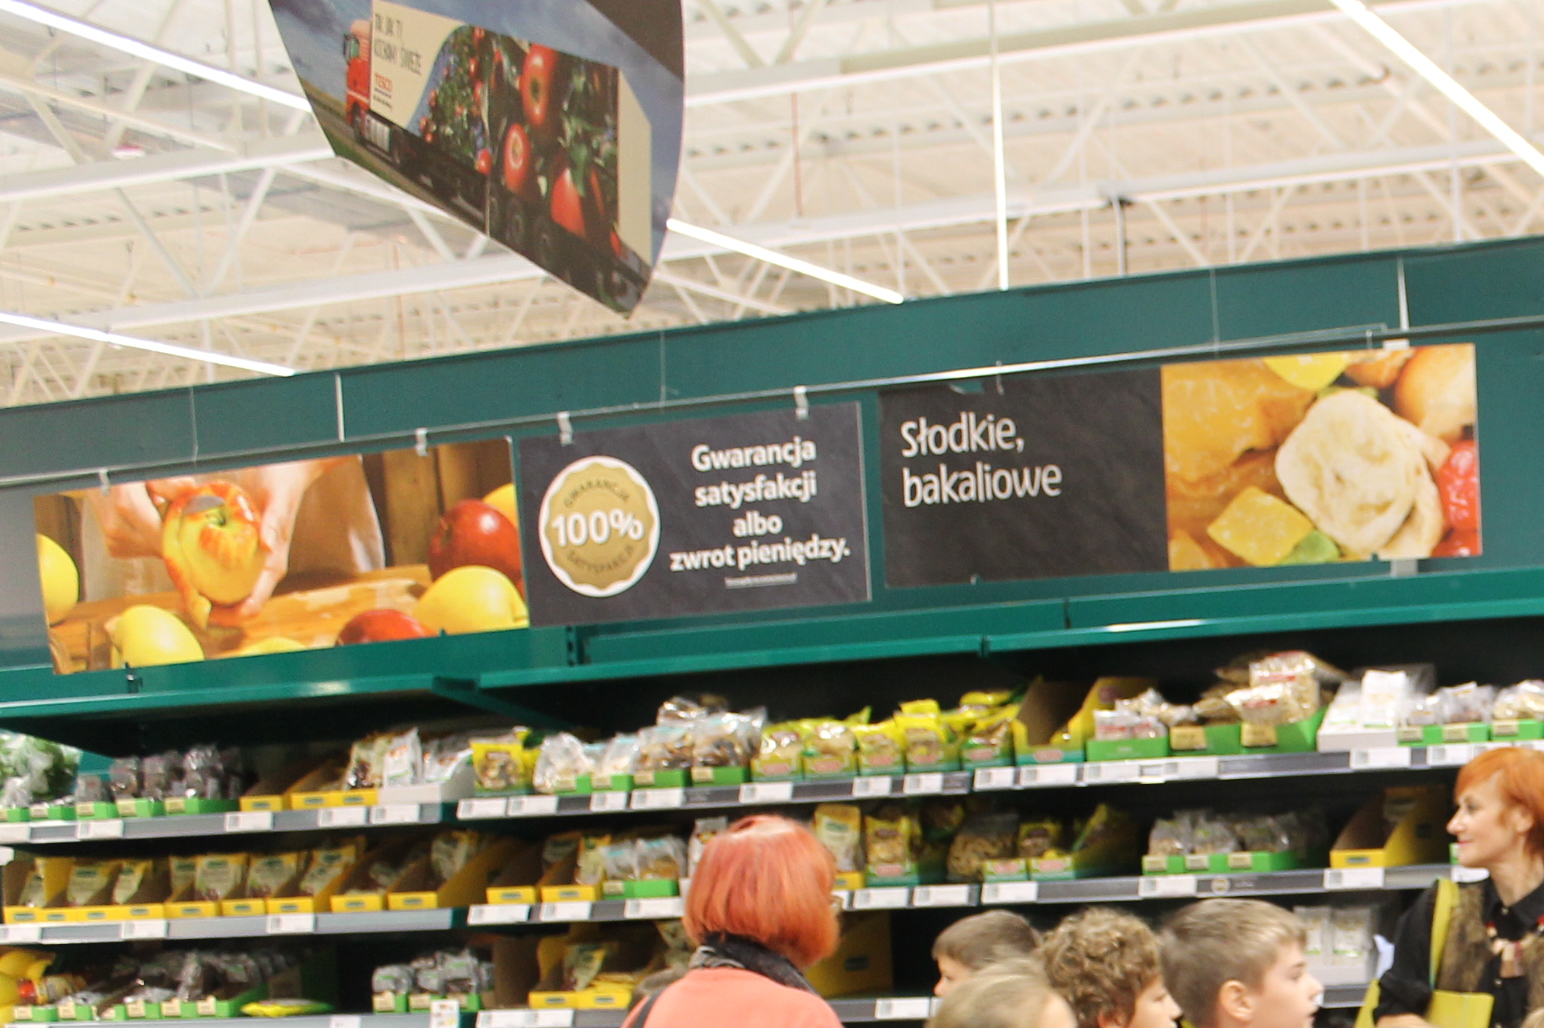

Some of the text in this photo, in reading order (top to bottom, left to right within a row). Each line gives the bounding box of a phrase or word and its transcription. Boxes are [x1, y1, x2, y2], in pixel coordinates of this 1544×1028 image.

[900, 410, 1025, 457] Słodkie,
[691, 436, 817, 472] Gwarancja
[695, 469, 818, 510] satysfakcji
[902, 460, 1063, 508] bakaliowe
[552, 508, 645, 548] 100%
[733, 511, 783, 538] albo
[669, 533, 852, 572] zwrot pieniędzy.
